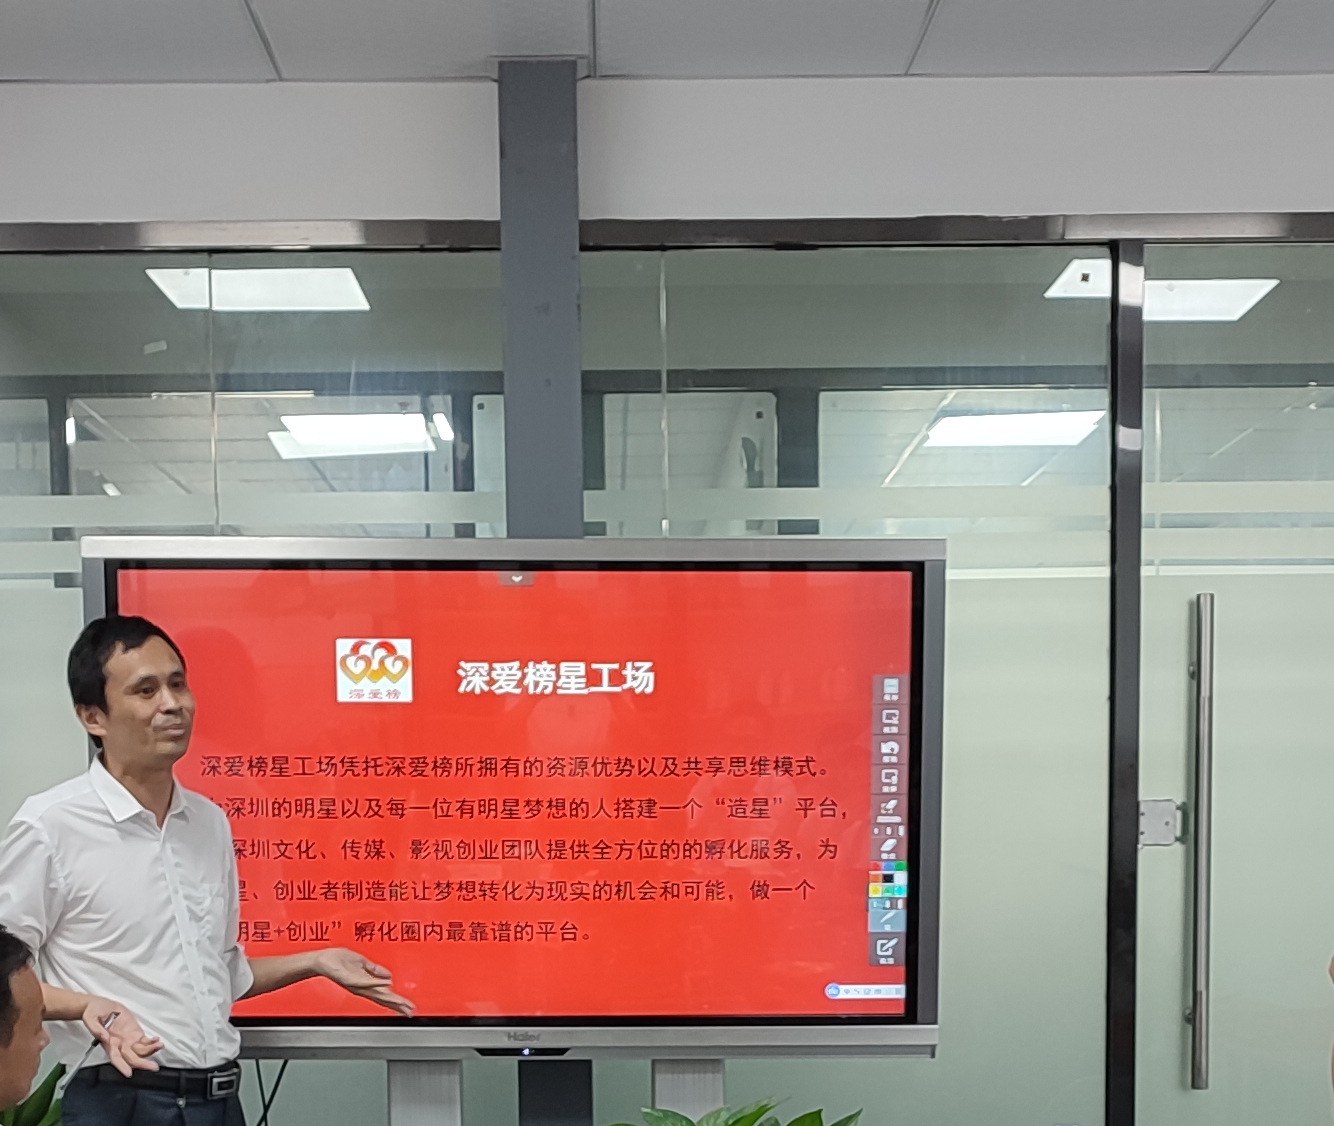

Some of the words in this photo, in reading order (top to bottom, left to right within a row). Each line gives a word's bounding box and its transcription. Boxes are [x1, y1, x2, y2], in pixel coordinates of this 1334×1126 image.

[456, 660, 655, 695] 深爱榜星工场
[210, 797, 847, 820] 深圳的明星以及每一位有明星梦想的人搭建一个“造星”平台，
